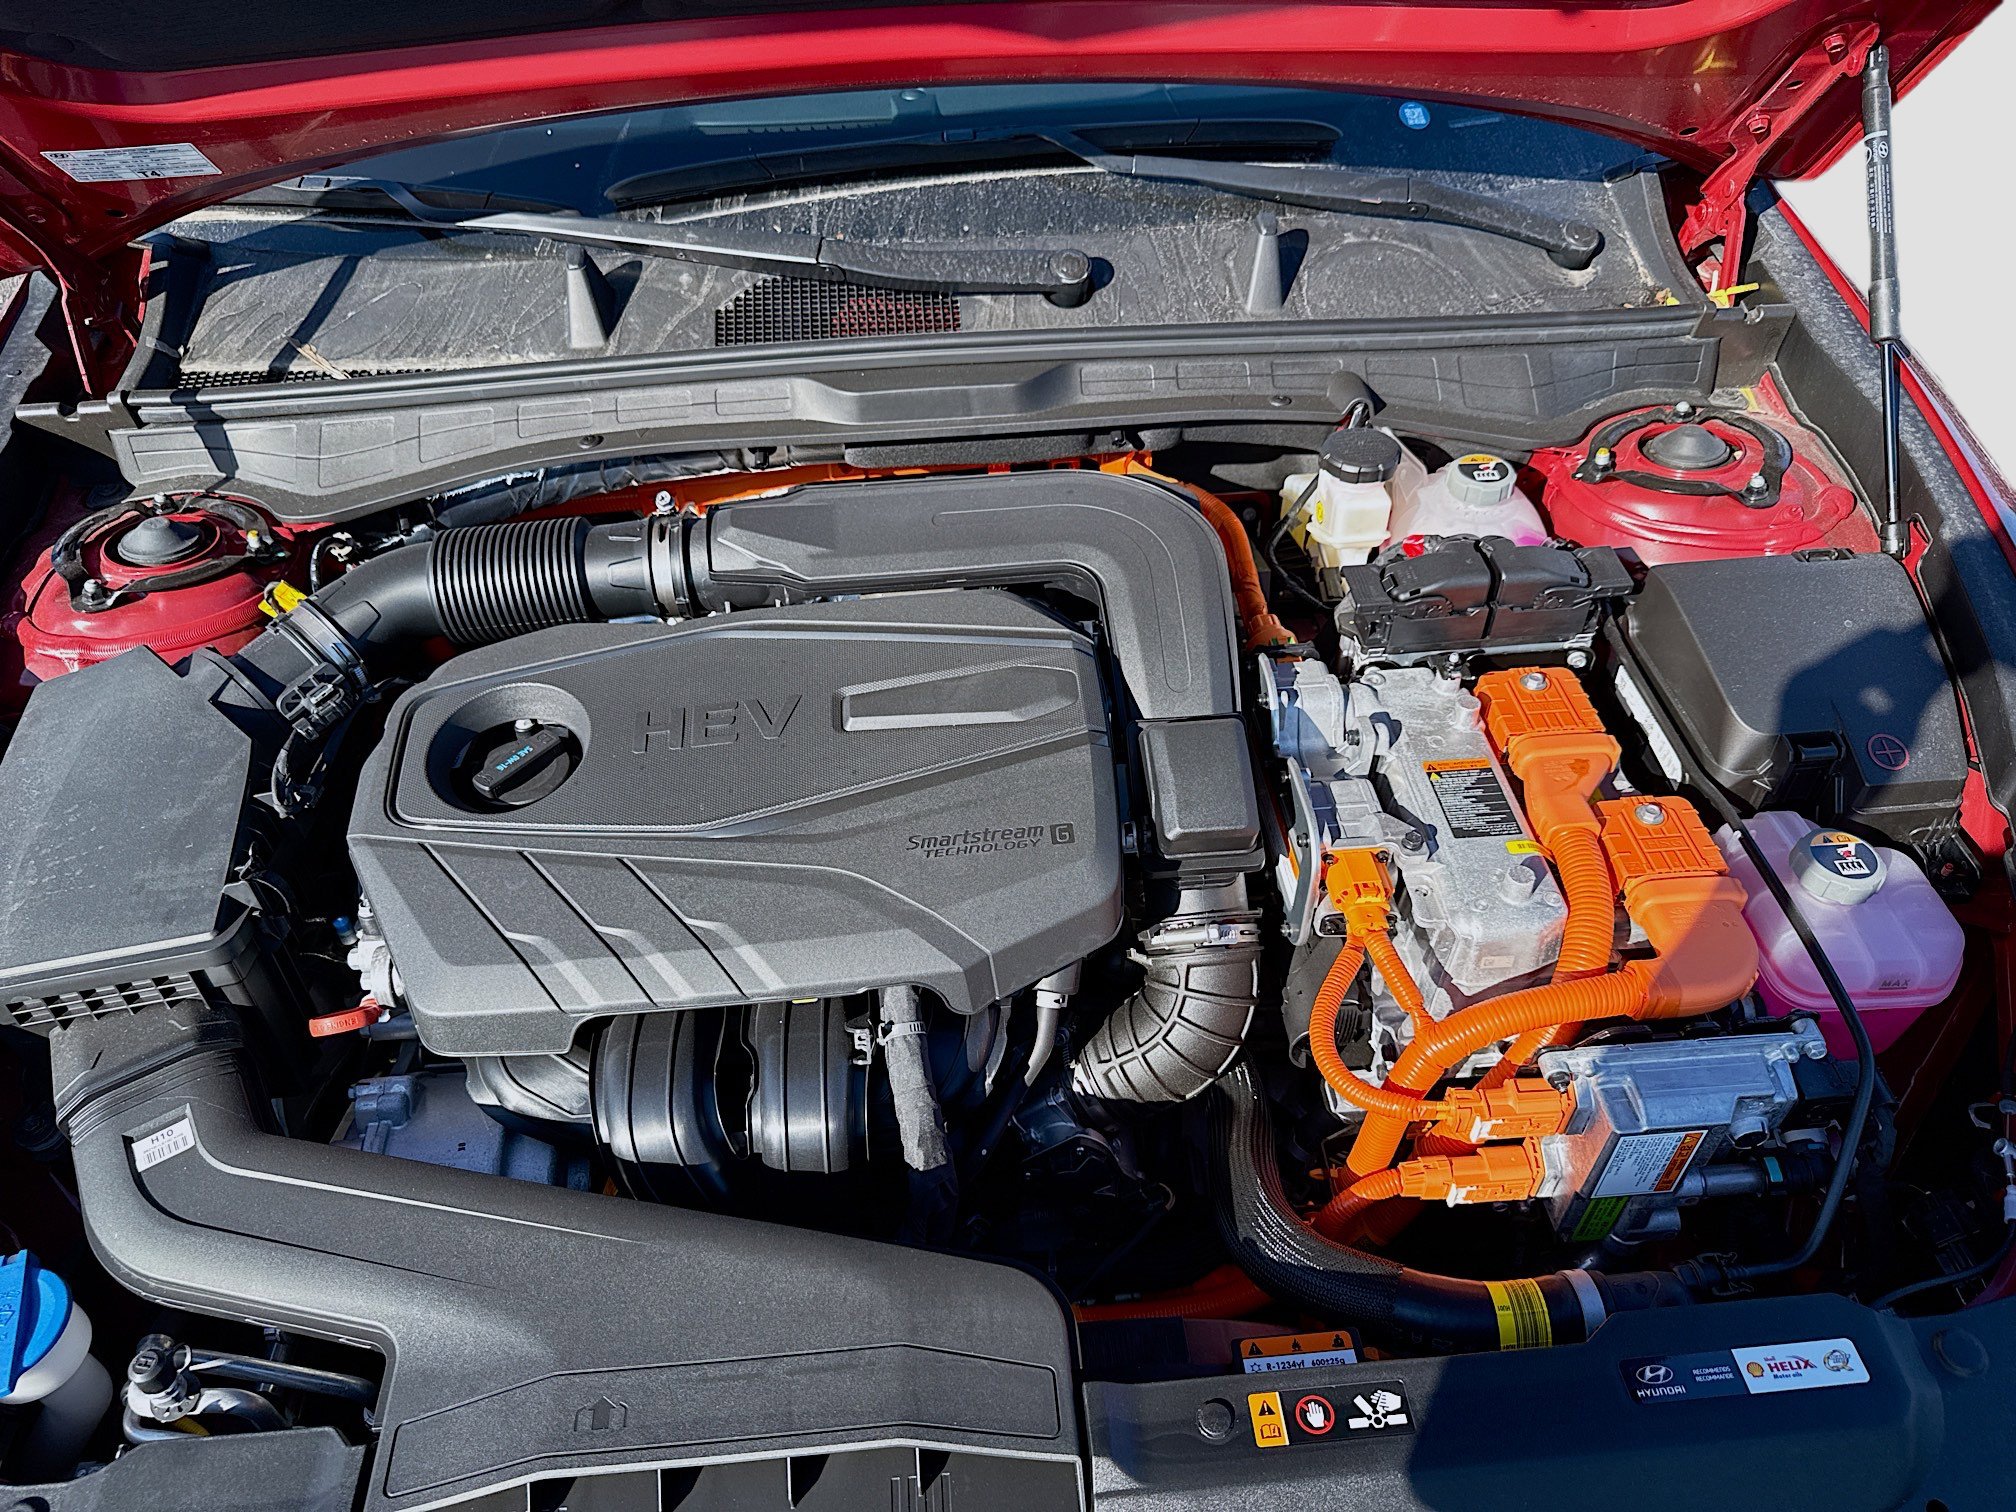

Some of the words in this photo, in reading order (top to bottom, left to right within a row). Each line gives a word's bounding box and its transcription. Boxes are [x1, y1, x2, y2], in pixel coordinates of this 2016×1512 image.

[632, 694, 802, 754] HEV
[906, 825, 1045, 850] Smartstream
[923, 838, 1042, 859] TECHNOLOGY
[151, 1129, 174, 1144] H10
[1266, 1360, 1305, 1370] R-1234yf
[1311, 1358, 1346, 1366] 600±25g
[1692, 1365, 1731, 1375] RECOMMENDS
[1767, 1359, 1815, 1373] HELIX
[1636, 1384, 1687, 1398] HYUNDAI
